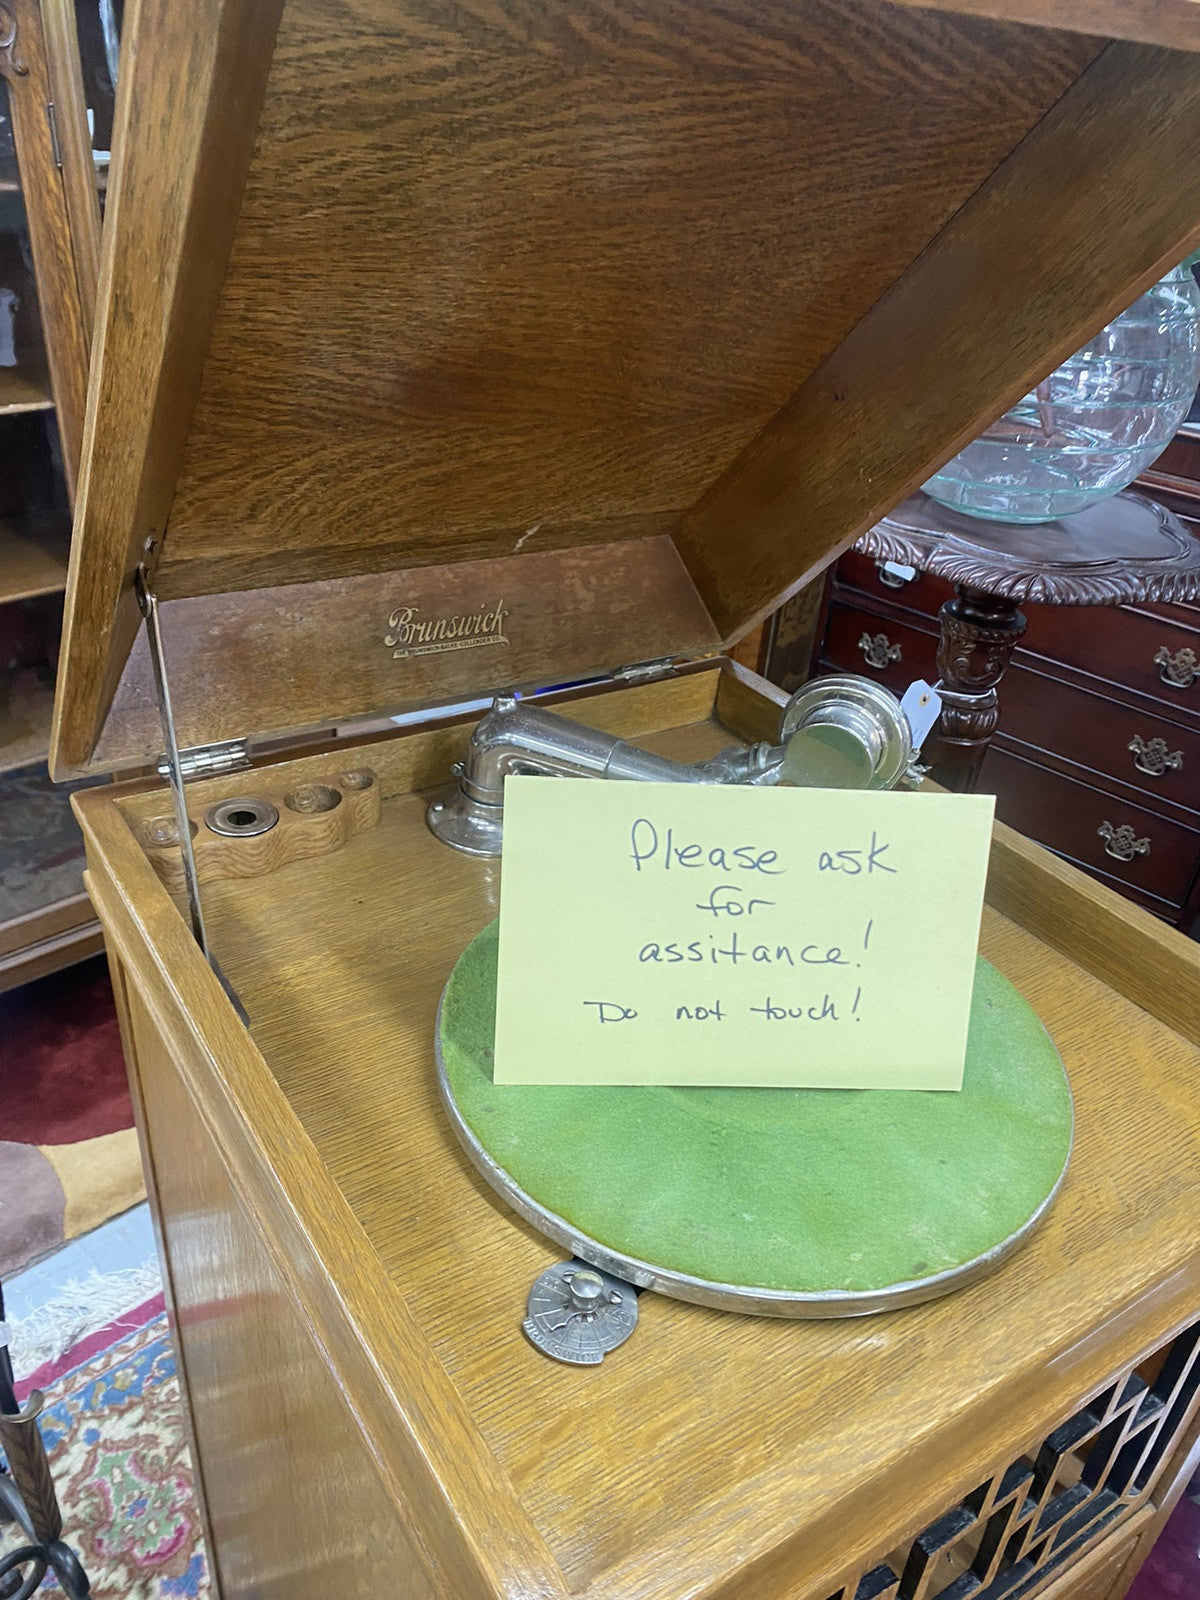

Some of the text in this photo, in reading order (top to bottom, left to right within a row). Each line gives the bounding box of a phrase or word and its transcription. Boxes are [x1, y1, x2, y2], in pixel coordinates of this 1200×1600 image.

[384, 599, 509, 647] Brunswick
[629, 817, 898, 876] Please ask
[695, 885, 776, 918] for
[638, 918, 874, 969] assitance!
[582, 986, 862, 1024] Do not touch!
